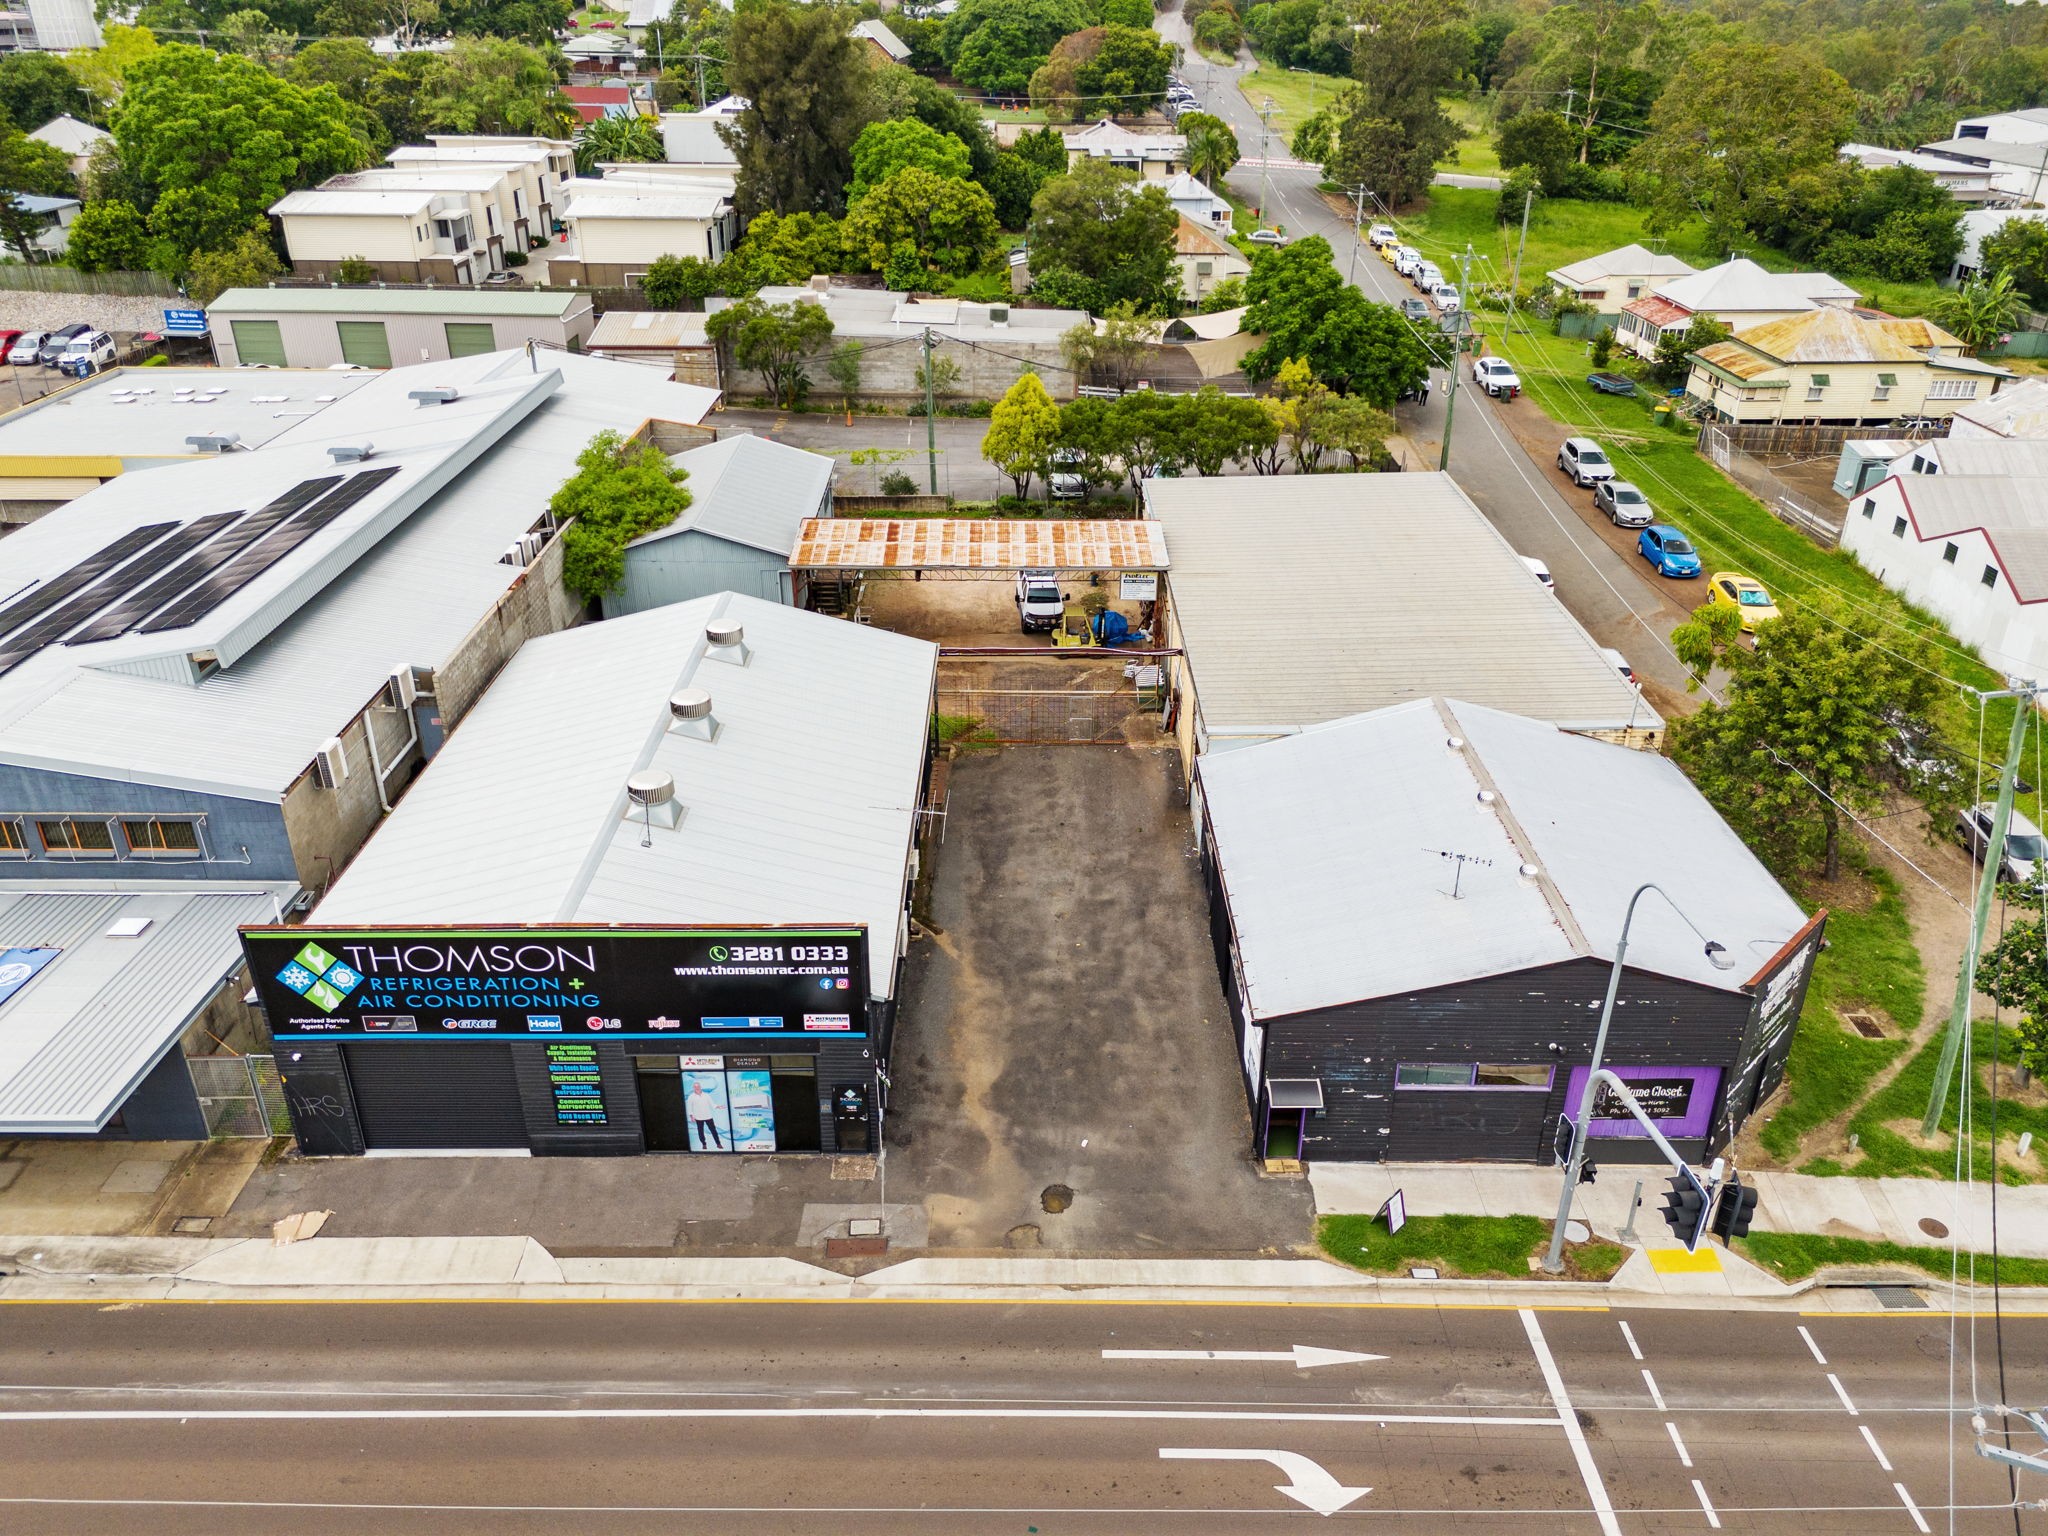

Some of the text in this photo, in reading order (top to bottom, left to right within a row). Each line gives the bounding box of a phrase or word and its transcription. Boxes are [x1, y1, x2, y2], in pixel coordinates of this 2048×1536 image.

[343, 945, 596, 973] THOMSON
[730, 946, 849, 962] 3281 0333
[673, 965, 849, 976] www.thomsonrac.com.au
[370, 976, 560, 991] REFRIGERATION
[358, 994, 600, 1008] AIR CONDITIONING
[458, 1019, 497, 1029] GREE
[529, 1019, 560, 1028] Haier
[604, 1018, 622, 1029] LG
[1651, 1085, 1683, 1097] Closet
